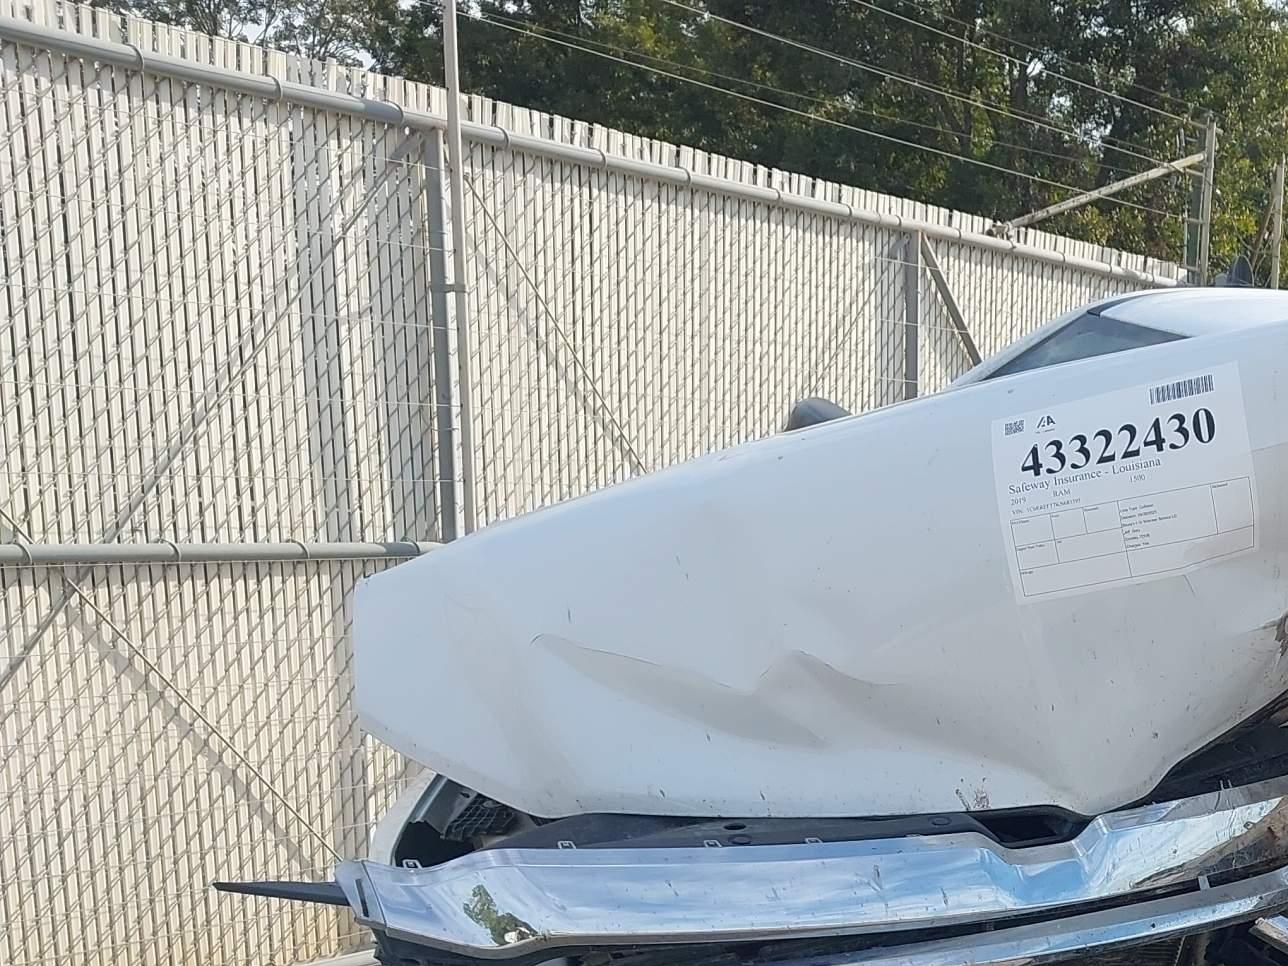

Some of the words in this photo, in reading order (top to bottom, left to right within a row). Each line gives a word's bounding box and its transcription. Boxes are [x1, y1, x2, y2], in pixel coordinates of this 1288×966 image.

[1021, 407, 1216, 477] 43322430
[1008, 480, 1050, 495] Safeway
[1053, 469, 1102, 486] Insurance
[1112, 457, 1161, 475] Louisiana
[1011, 497, 1027, 506] 2019
[1053, 489, 1071, 498] RAM
